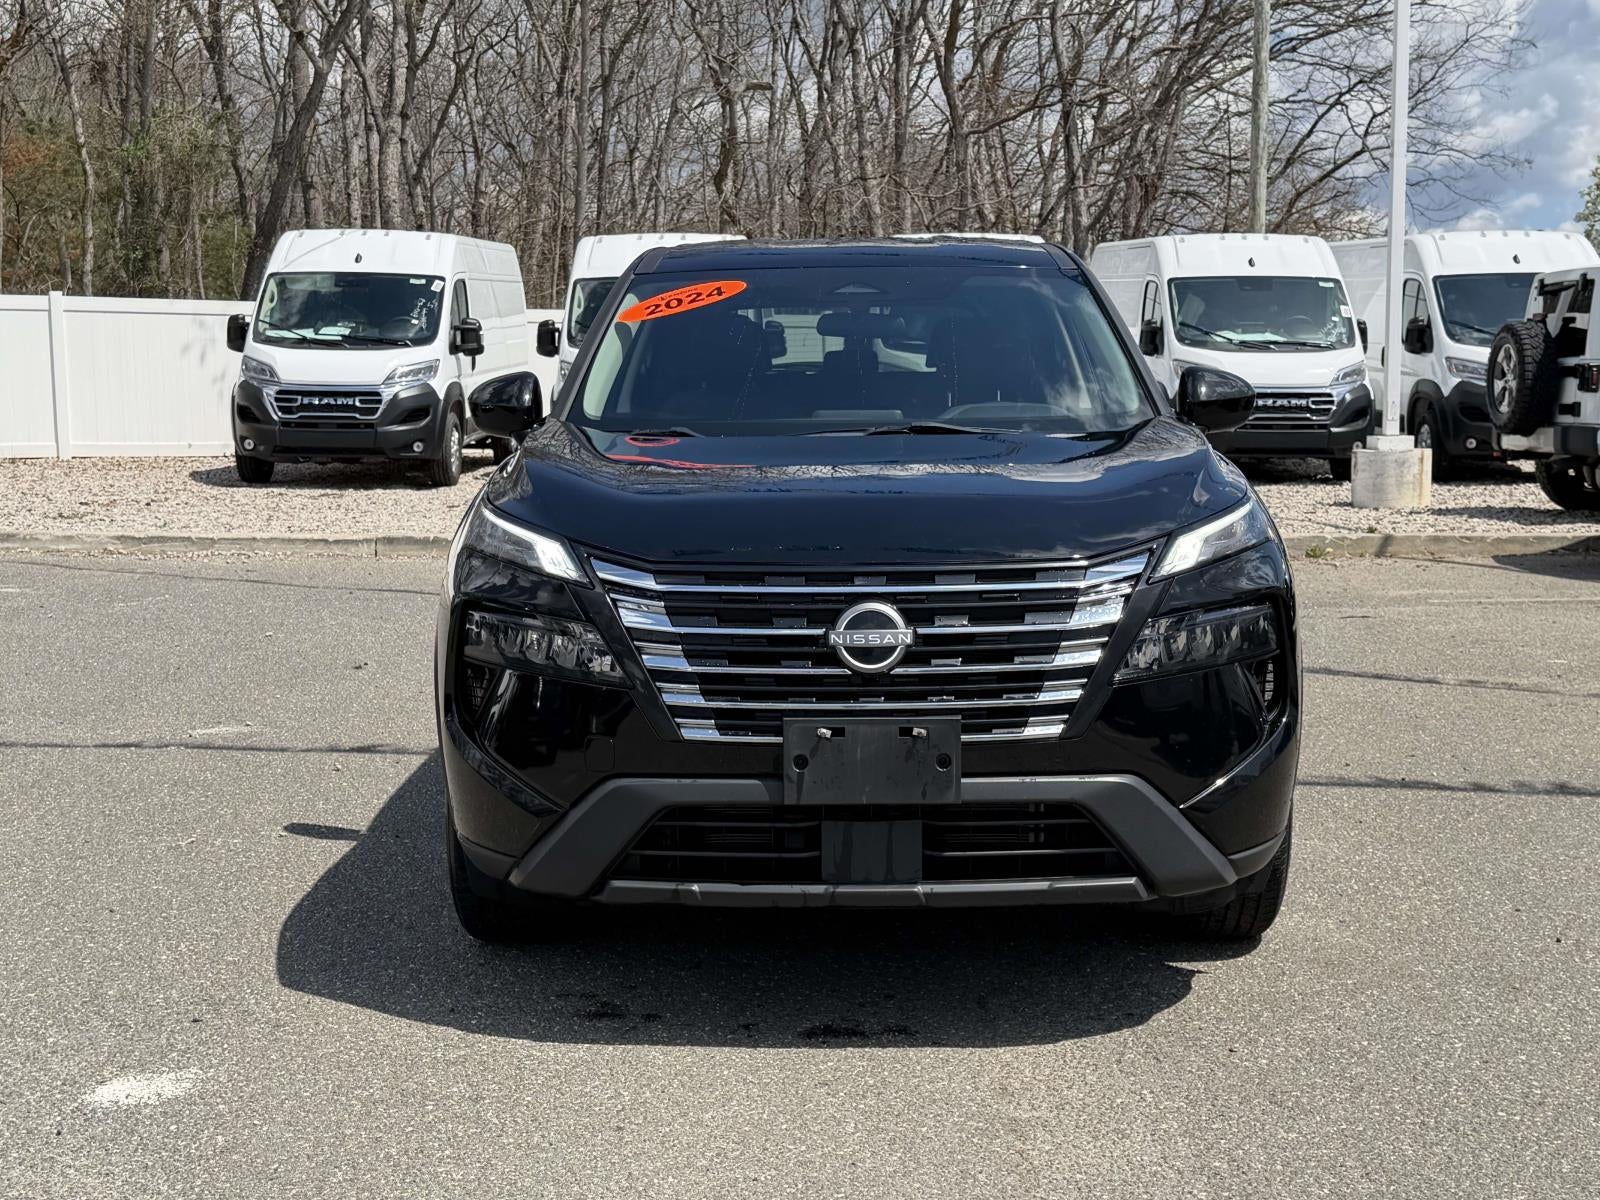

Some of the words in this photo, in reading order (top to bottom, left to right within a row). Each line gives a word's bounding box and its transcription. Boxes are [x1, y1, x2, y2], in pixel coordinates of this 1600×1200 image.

[645, 286, 725, 316] 2024
[302, 397, 353, 405] RAM
[1257, 398, 1307, 407] RAM
[831, 633, 911, 644] NISSAN
